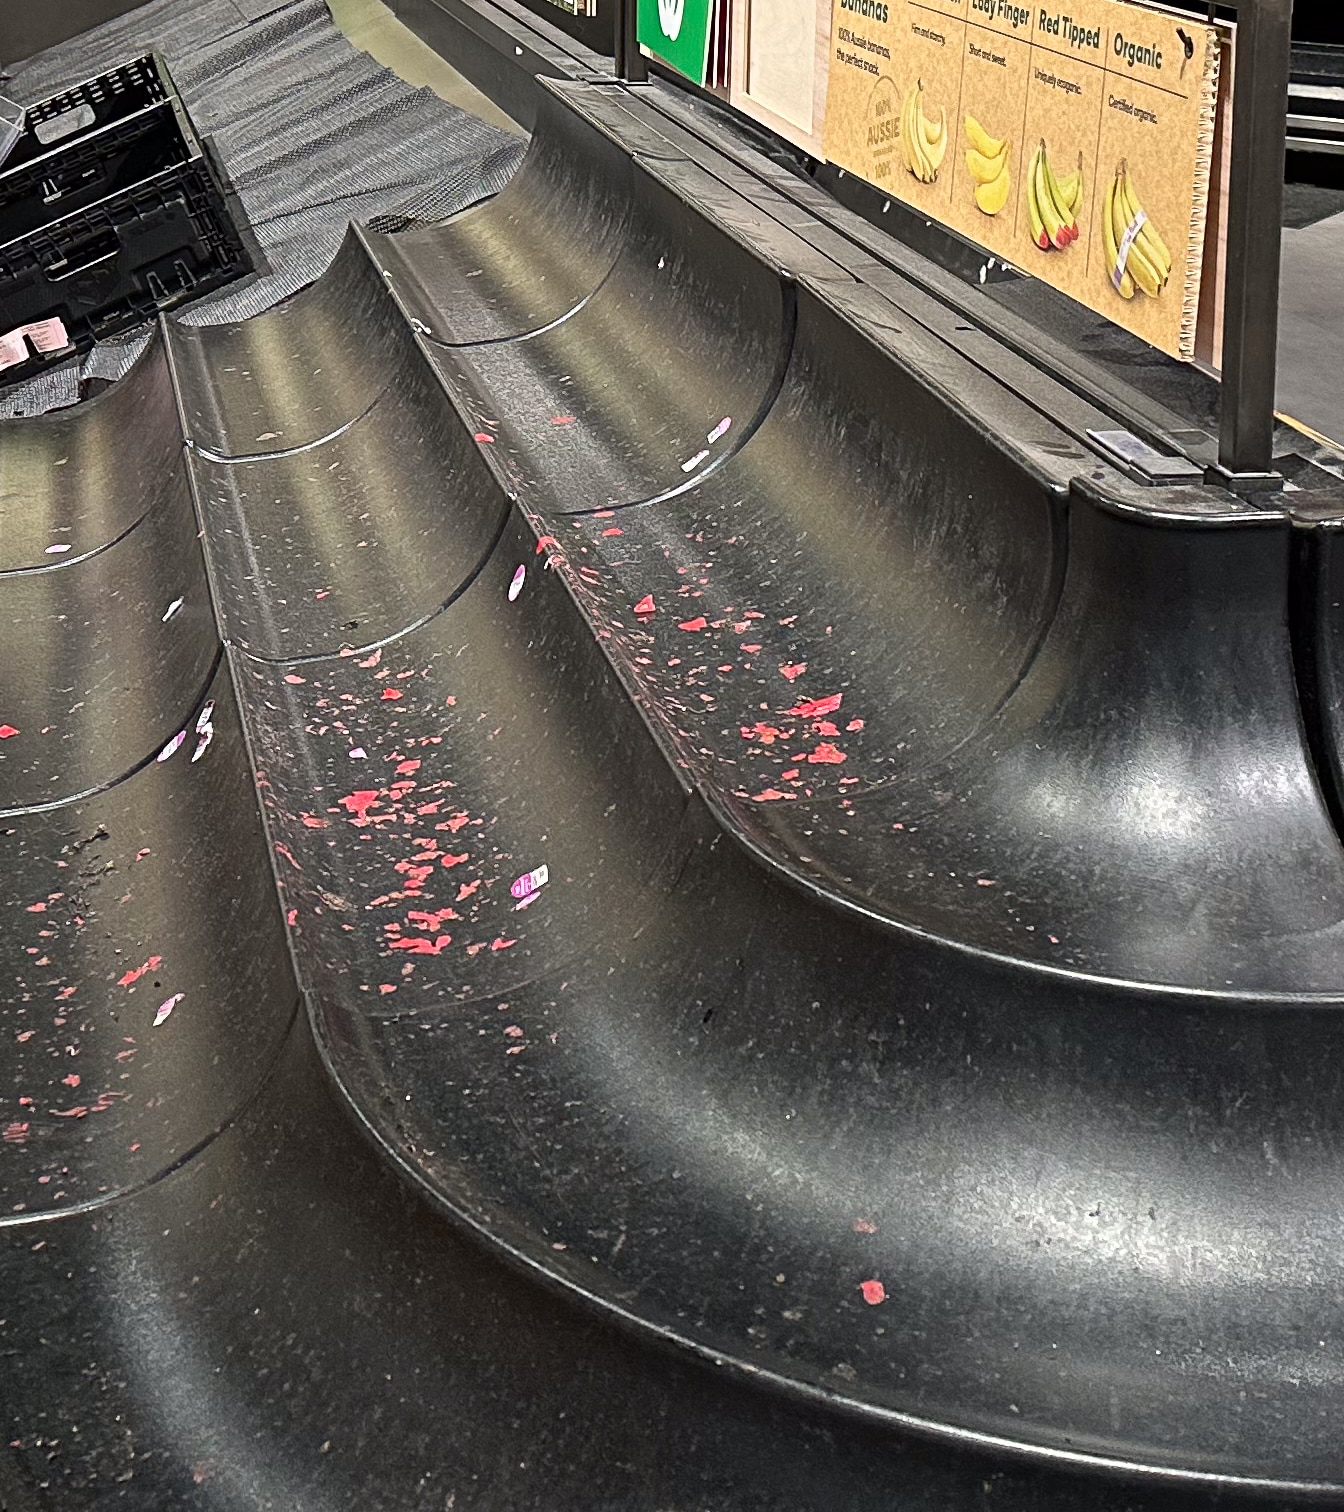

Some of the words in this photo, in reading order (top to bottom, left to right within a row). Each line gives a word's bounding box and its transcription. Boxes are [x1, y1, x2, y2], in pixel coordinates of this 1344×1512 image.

[1039, 9, 1060, 35] Red
[1062, 16, 1101, 49] Tipped
[836, 48, 845, 60] the
[982, 50, 992, 62] and
[1114, 33, 1163, 69] Organic
[1108, 94, 1134, 115] Certified
[867, 117, 900, 147] AUSSIE
